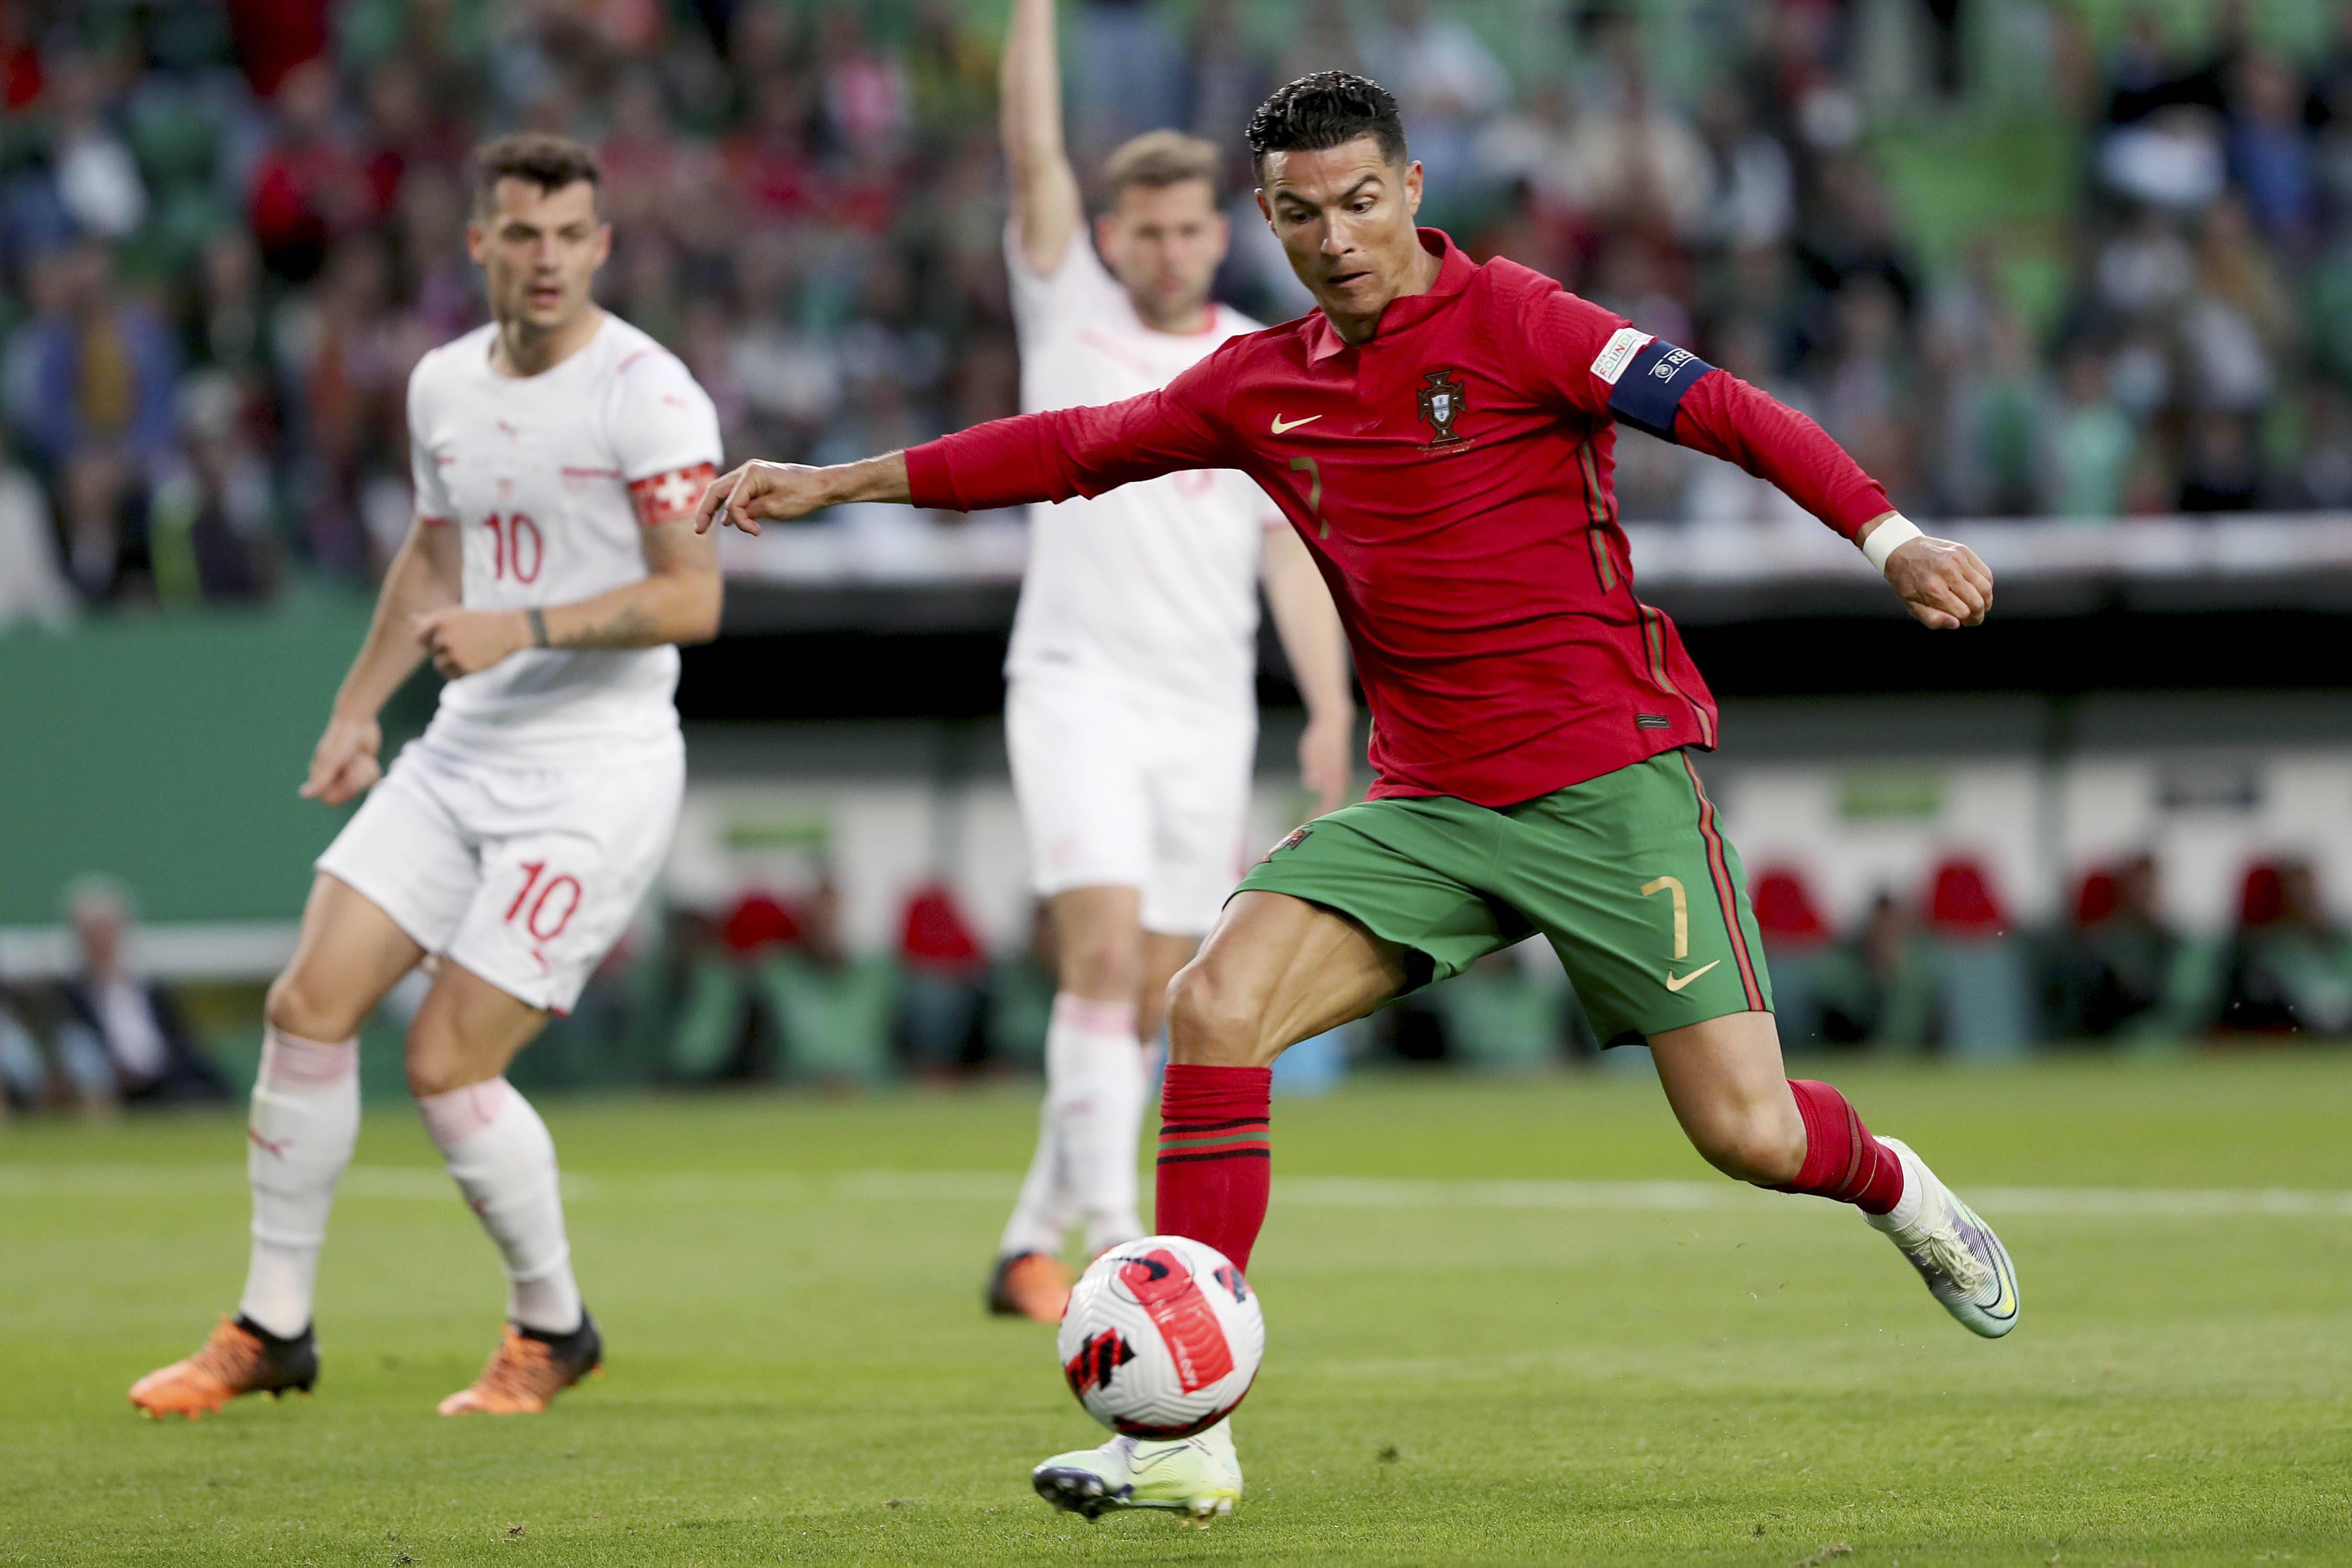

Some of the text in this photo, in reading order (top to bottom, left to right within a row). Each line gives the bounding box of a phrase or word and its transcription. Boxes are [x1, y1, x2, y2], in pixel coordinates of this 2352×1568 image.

[1288, 456, 1329, 540] 7
[481, 511, 544, 585] 10
[504, 861, 581, 941] 10
[1640, 875, 1688, 960] 7
